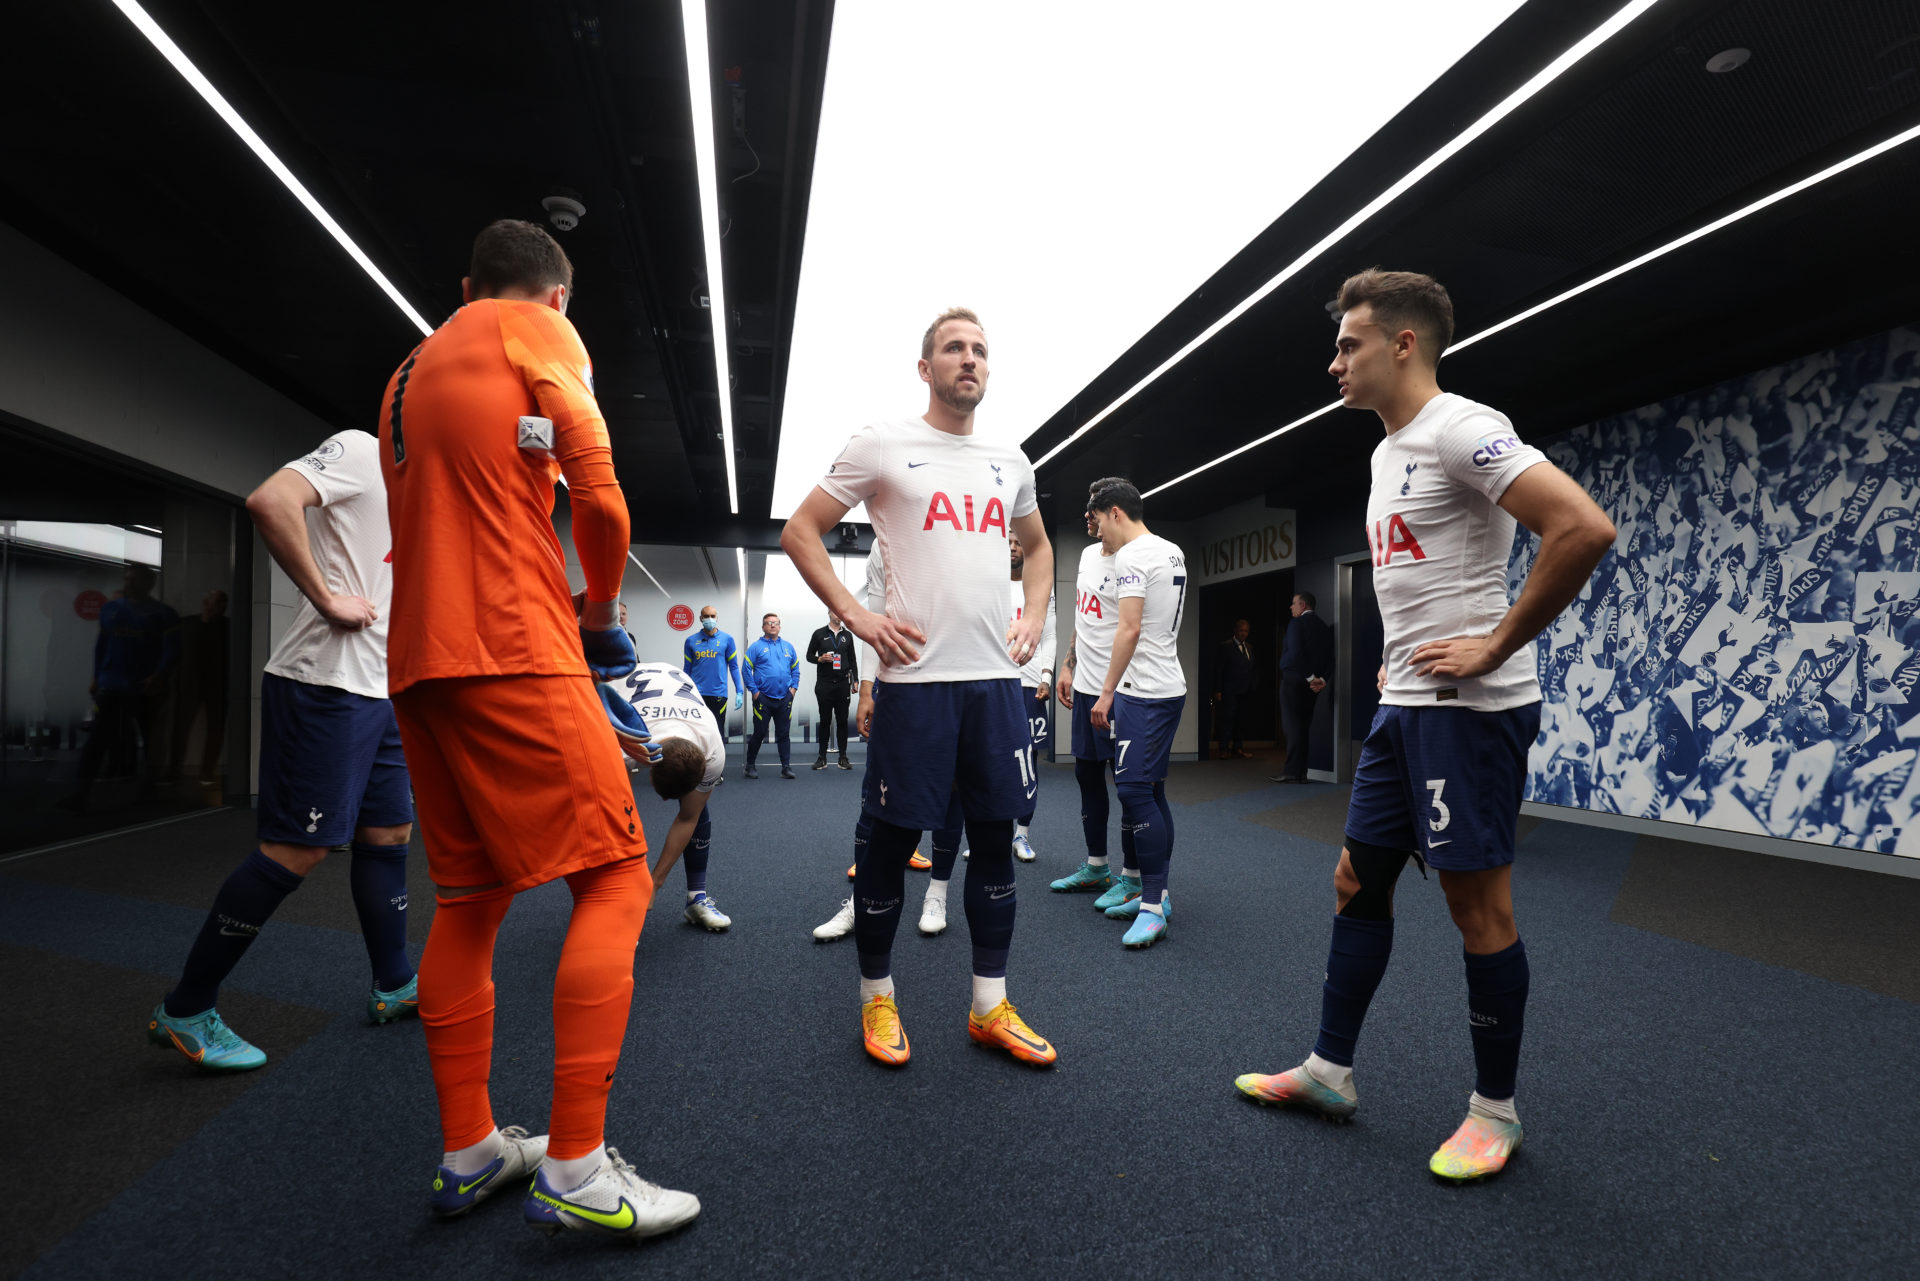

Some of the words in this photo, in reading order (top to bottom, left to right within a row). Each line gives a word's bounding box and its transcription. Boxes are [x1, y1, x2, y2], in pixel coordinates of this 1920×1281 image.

[923, 491, 1006, 539] AIA
[1843, 475, 1880, 524] SPURS
[1203, 519, 1294, 577] VISITORS
[1366, 513, 1427, 568] IA
[1173, 575, 1186, 632] 7
[1672, 601, 1706, 646] SPURS
[695, 649, 718, 660] getir
[640, 706, 702, 719] DAVIES
[1028, 717, 1048, 737] 12
[1118, 740, 1131, 767] 7
[1426, 779, 1451, 832] 3
